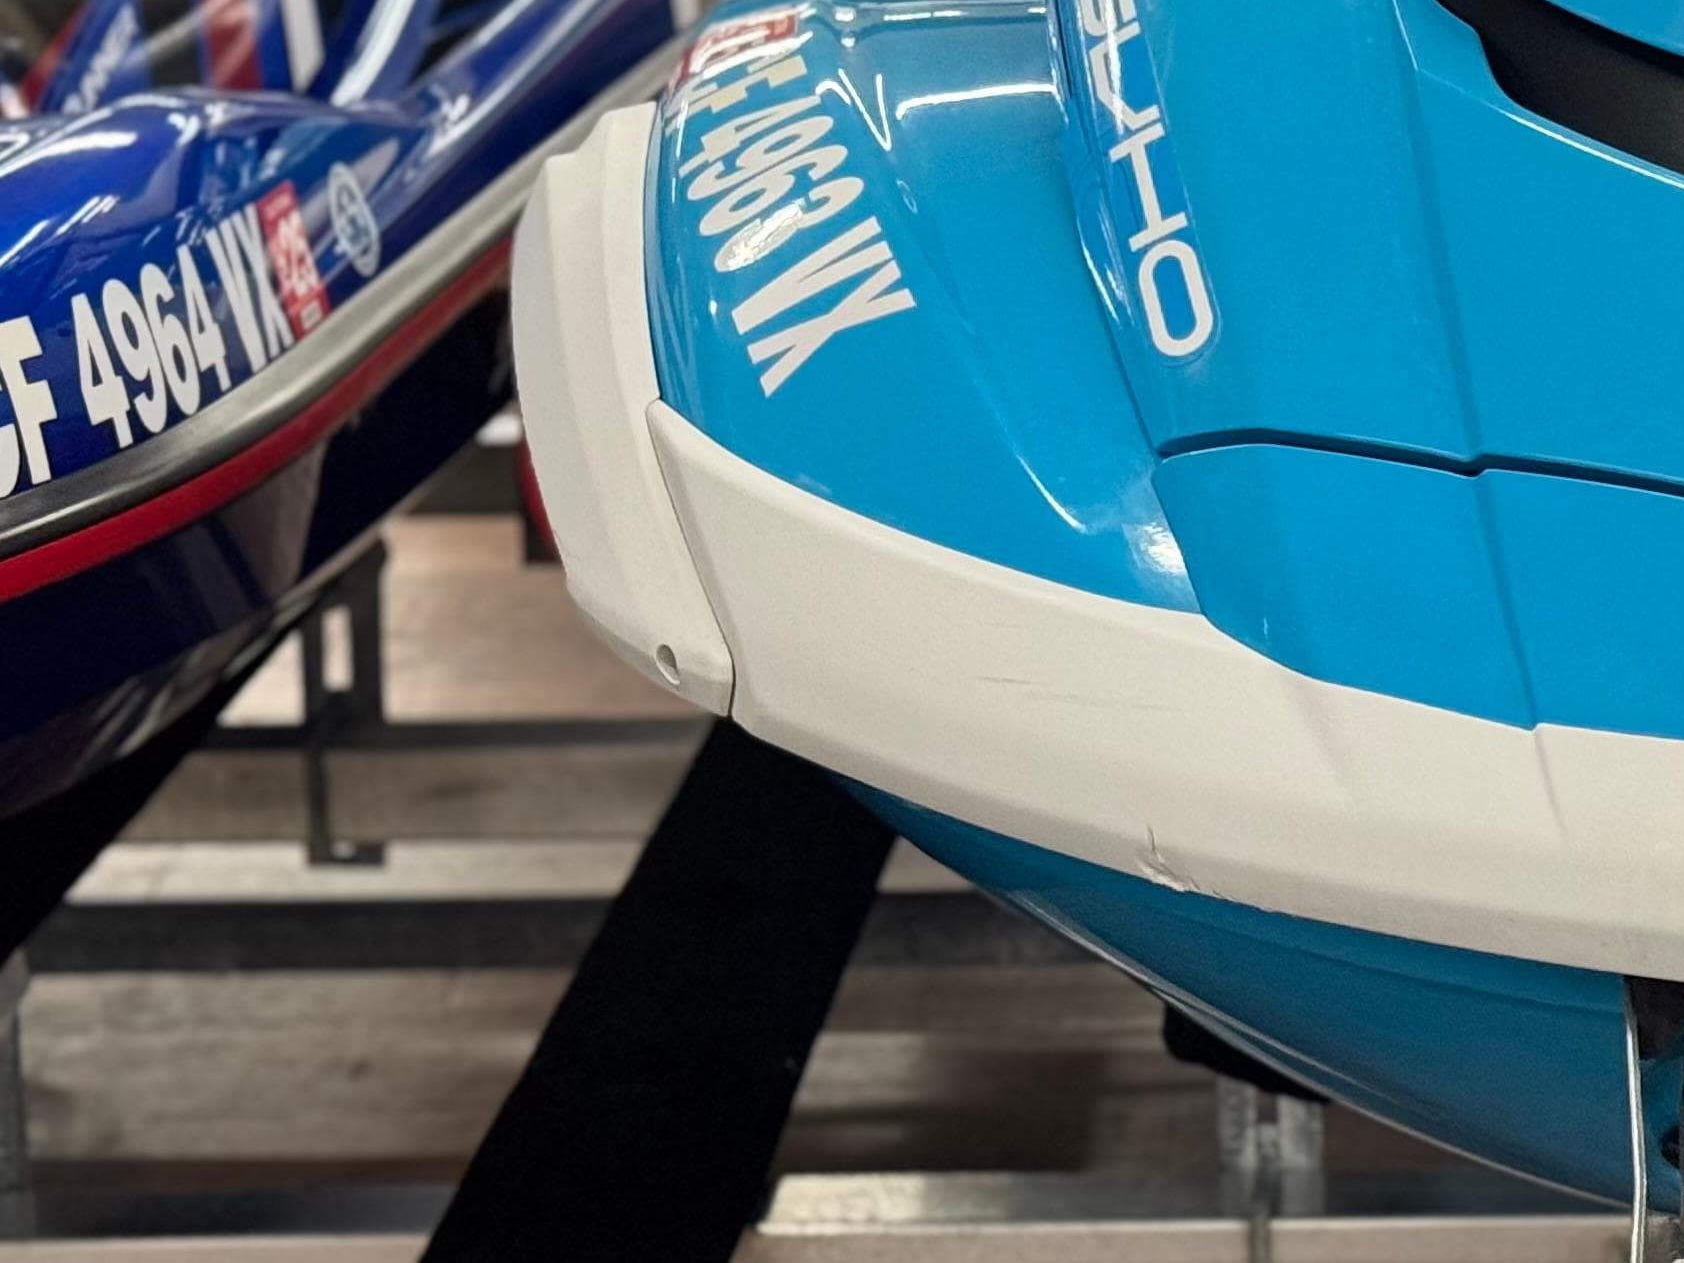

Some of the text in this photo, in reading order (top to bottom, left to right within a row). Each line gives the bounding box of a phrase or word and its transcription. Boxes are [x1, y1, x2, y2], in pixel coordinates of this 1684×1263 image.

[679, 95, 865, 273] 4963
[71, 246, 232, 449] 4964
[206, 205, 294, 373] VX
[731, 216, 916, 398] VX
